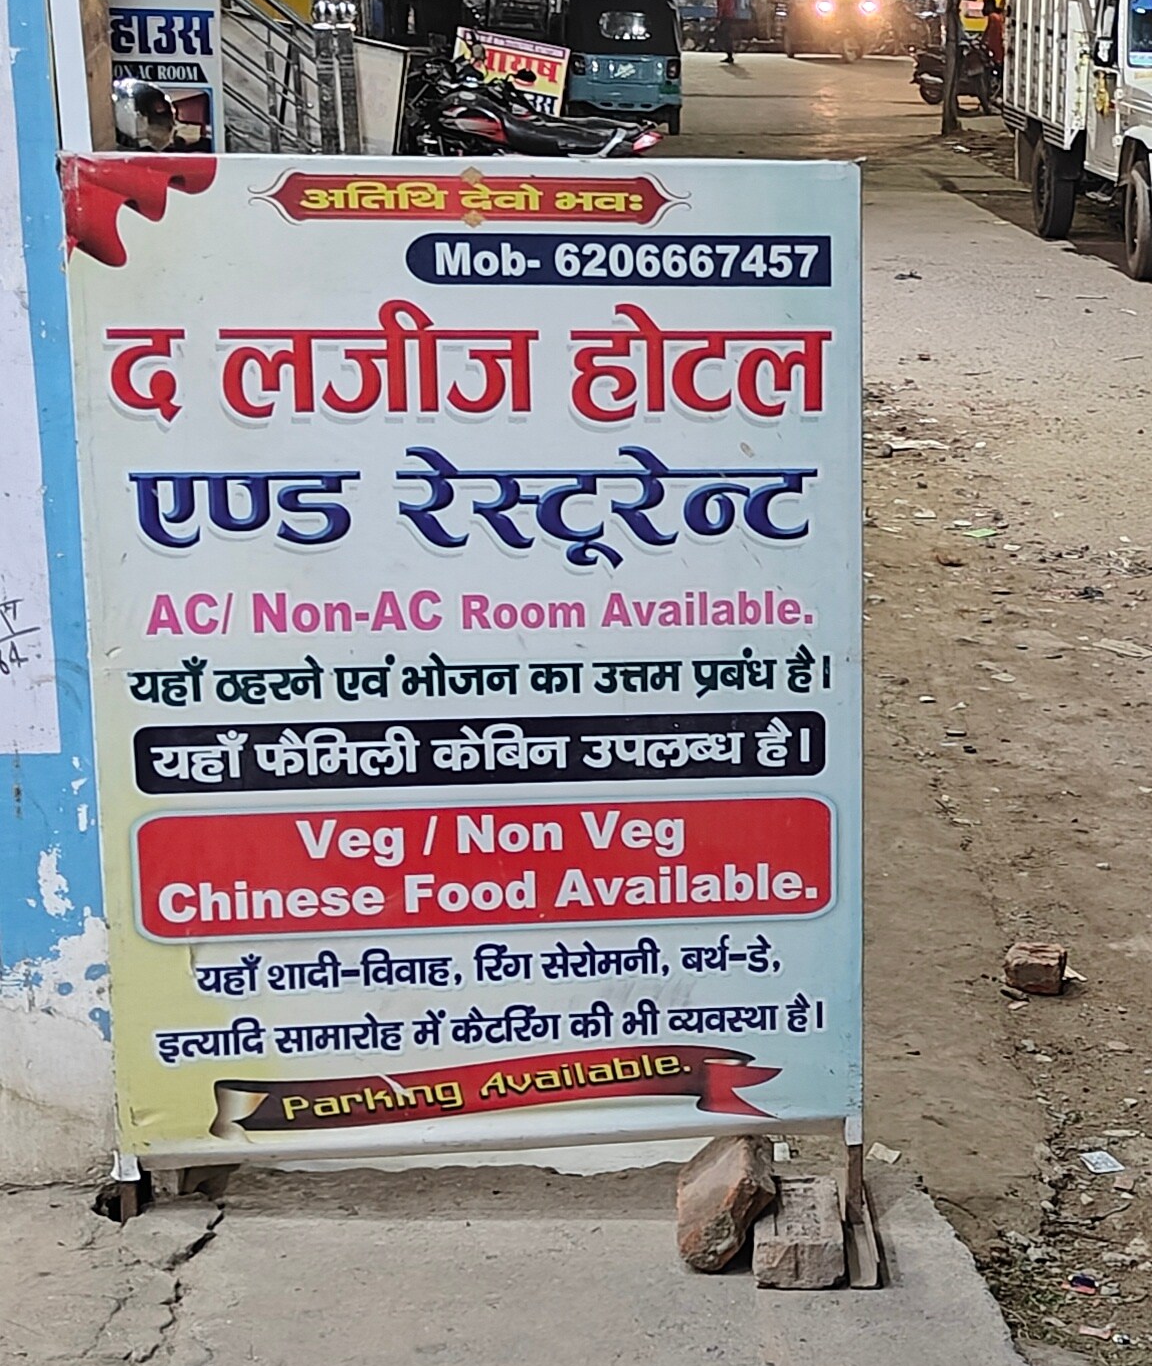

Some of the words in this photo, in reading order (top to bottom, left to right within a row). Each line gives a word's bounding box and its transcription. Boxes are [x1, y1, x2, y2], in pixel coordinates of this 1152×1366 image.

[109, 8, 214, 56] हाउस
[157, 66, 199, 81] ROOM
[299, 181, 446, 212] अतिथि
[458, 183, 542, 213] देवो
[553, 189, 644, 213] भवः
[435, 242, 541, 277] Mob-
[554, 244, 818, 278] 6206667457
[105, 328, 185, 419] द
[219, 299, 539, 417] लजीज
[570, 304, 833, 422] होटल
[129, 470, 360, 548] एण्ड
[397, 446, 818, 567] रेस्टूरेन्ट
[146, 593, 231, 637] AC/
[253, 590, 442, 633] Non-AC
[461, 593, 586, 630] Room
[601, 591, 814, 628] Available.
[129, 660, 204, 706] यहाँ
[213, 656, 325, 702] ठहरने
[335, 655, 392, 700] एवं
[402, 656, 518, 699] भोजन
[531, 660, 583, 695] का
[594, 660, 681, 694] उत्तम
[693, 648, 776, 695] प्रबंध
[151, 732, 246, 782] यहाँ
[257, 728, 420, 780] फैमिली
[432, 723, 568, 773] केबिन
[582, 728, 744, 768] उपलब्ध
[296, 820, 405, 866] Veg
[458, 813, 564, 853] Non
[580, 811, 685, 854] Veg
[157, 881, 385, 923] Chinese
[405, 874, 537, 915] Food
[554, 867, 818, 908] Available.
[197, 955, 260, 996] यहाँ
[475, 948, 532, 983] रिंग
[156, 1020, 265, 1064] इत्यादि
[273, 1016, 403, 1056] सामारोह
[413, 1010, 446, 1049] में
[451, 1005, 561, 1047] कैटरिंग
[570, 1002, 613, 1040] की
[622, 999, 660, 1036] भी
[668, 1005, 778, 1036] व्यवस्था
[283, 1082, 463, 1120] Parking
[480, 1054, 693, 1101] Available.
